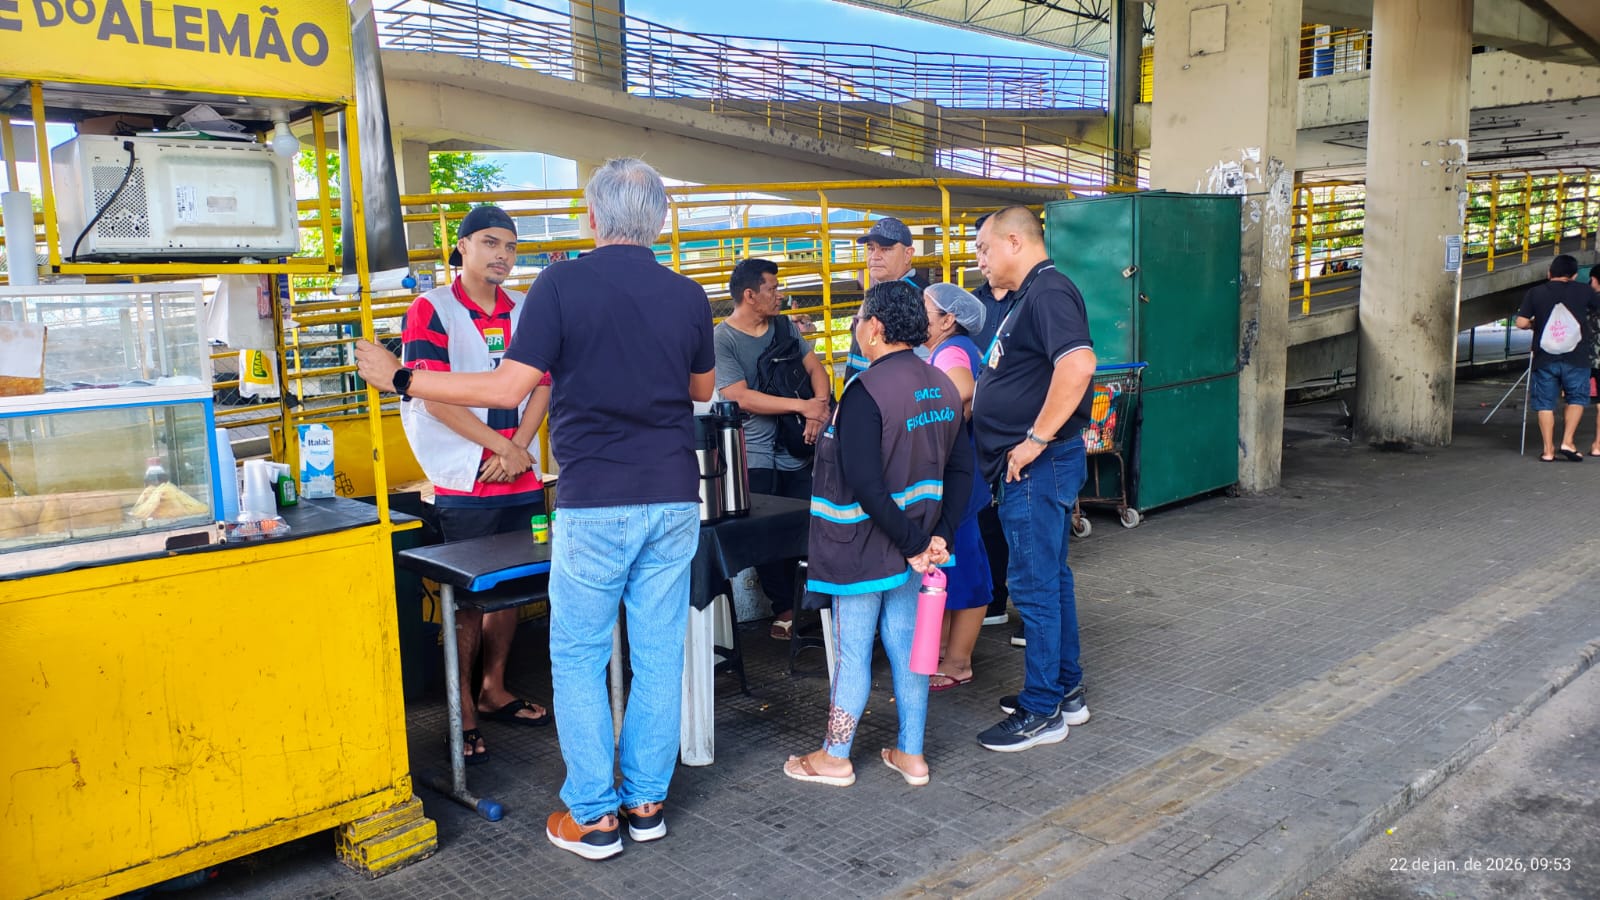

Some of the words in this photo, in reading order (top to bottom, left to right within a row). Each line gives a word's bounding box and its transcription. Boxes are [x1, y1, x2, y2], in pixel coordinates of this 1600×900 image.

[32, 0, 96, 28] DO
[97, 0, 330, 67] ALEMÃO
[487, 336, 503, 346] BR
